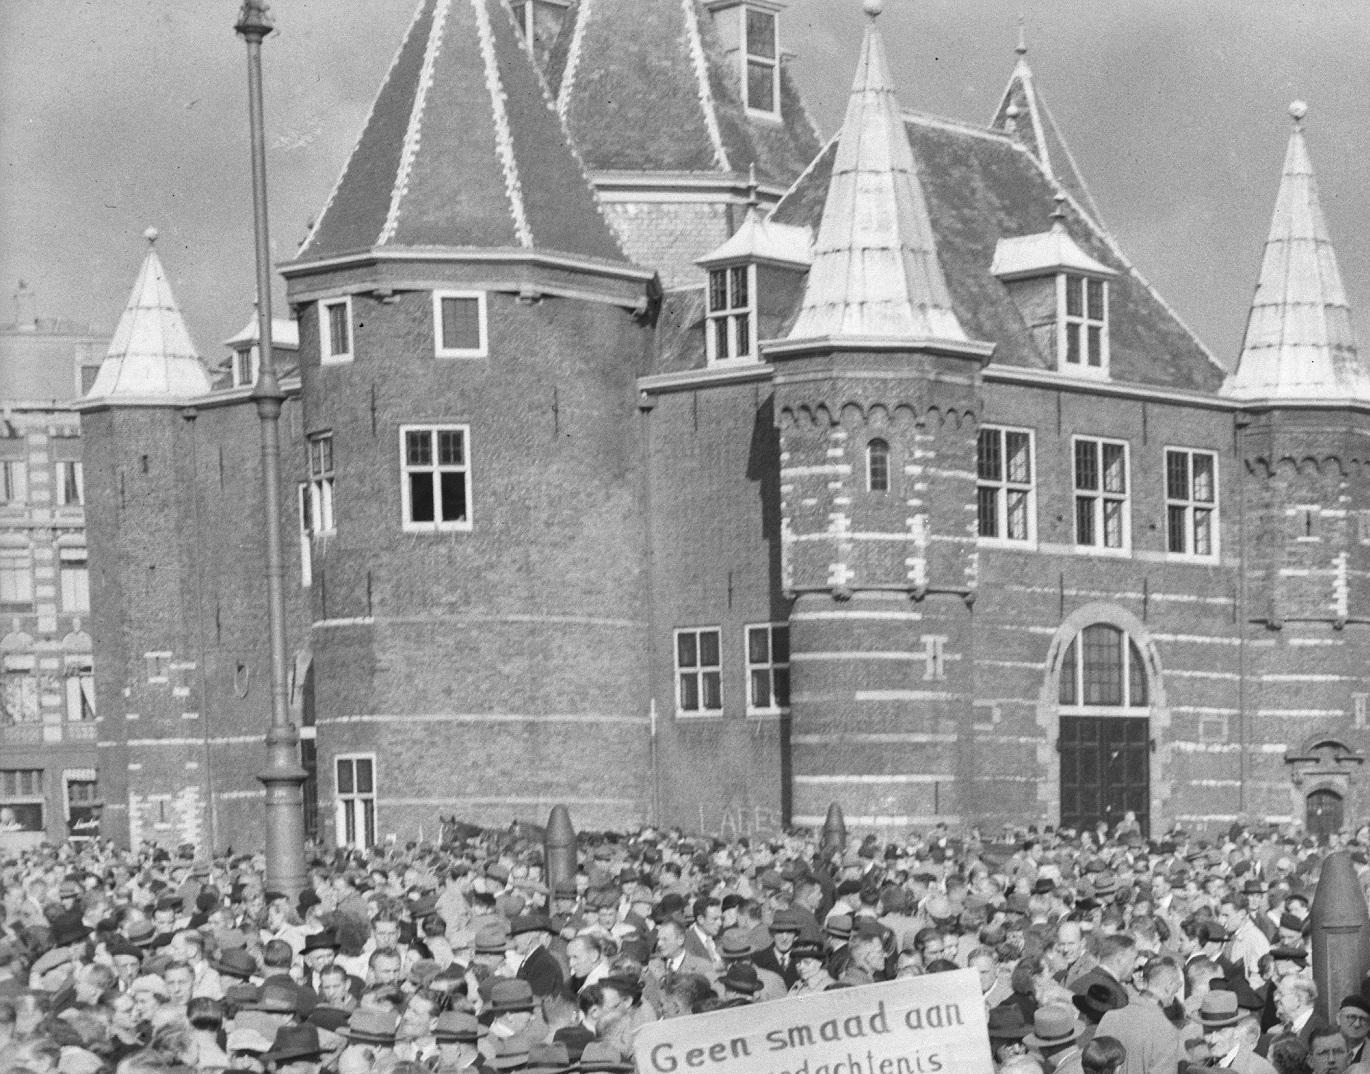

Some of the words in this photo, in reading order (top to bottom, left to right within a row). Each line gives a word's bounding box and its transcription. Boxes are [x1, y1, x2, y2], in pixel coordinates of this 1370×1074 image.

[650, 1035, 752, 1074] Geen
[766, 1000, 892, 1051] smaad
[904, 1001, 965, 1030] aan
